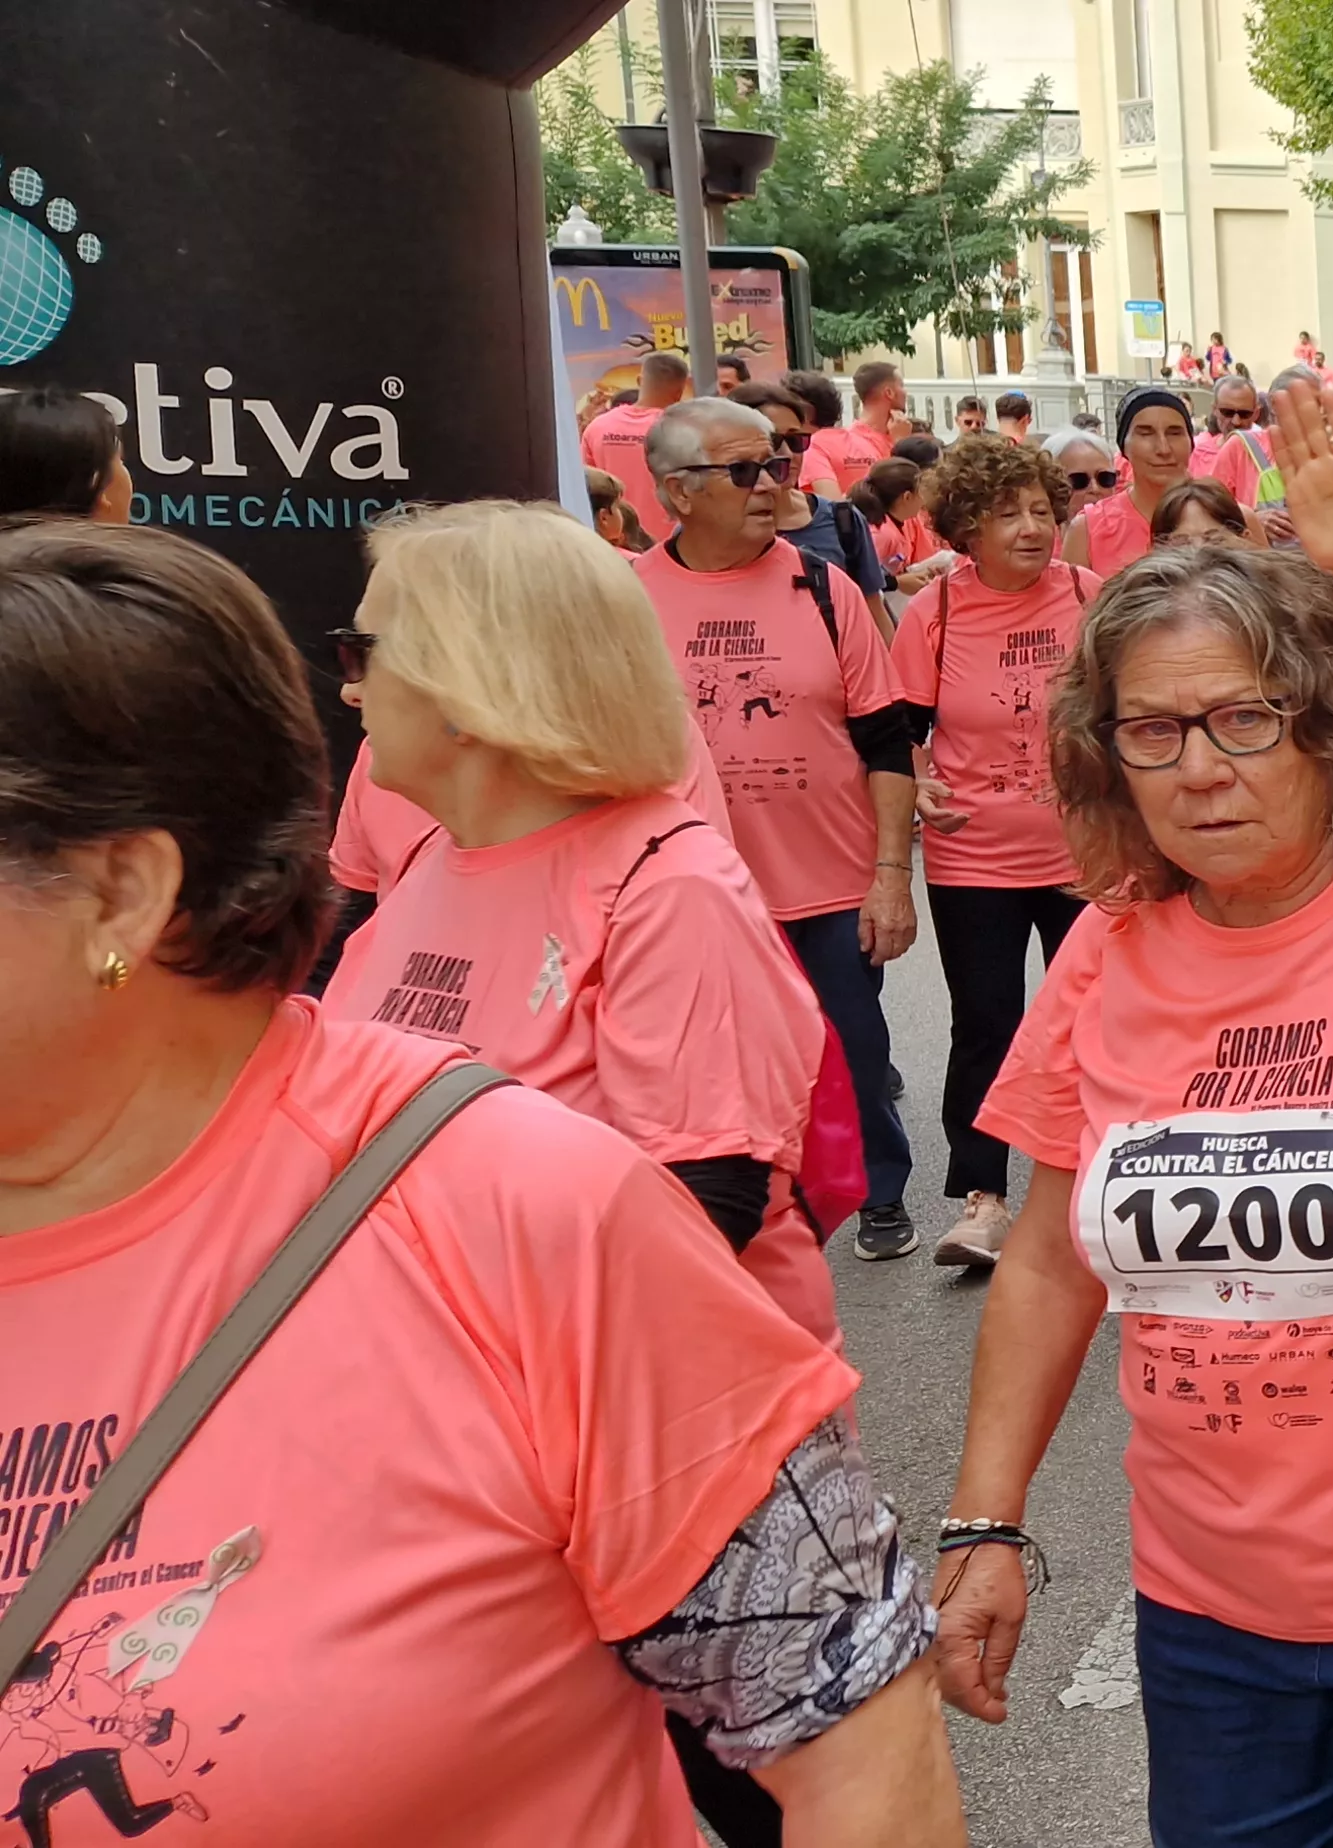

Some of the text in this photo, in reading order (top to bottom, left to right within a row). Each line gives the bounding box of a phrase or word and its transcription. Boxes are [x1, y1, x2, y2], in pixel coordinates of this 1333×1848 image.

[633, 252, 680, 261] URBAN
[697, 620, 756, 639] CORRAMOS
[1007, 628, 1056, 650] CORRAMOS
[685, 638, 765, 658] POR LA CIENCIA
[999, 650, 1017, 668] POR
[1019, 649, 1029, 665] LA
[1216, 1018, 1328, 1069] CORRAMOS
[1183, 1071, 1234, 1109] POR
[1230, 1069, 1259, 1106] LA
[1202, 1136, 1268, 1152] HUESCA
[1120, 1154, 1217, 1175] CONTRA
[1222, 1155, 1247, 1174] EL
[1269, 1350, 1315, 1360] URBAN
[93, 1570, 136, 1595] contra
[140, 1570, 152, 1586] el
